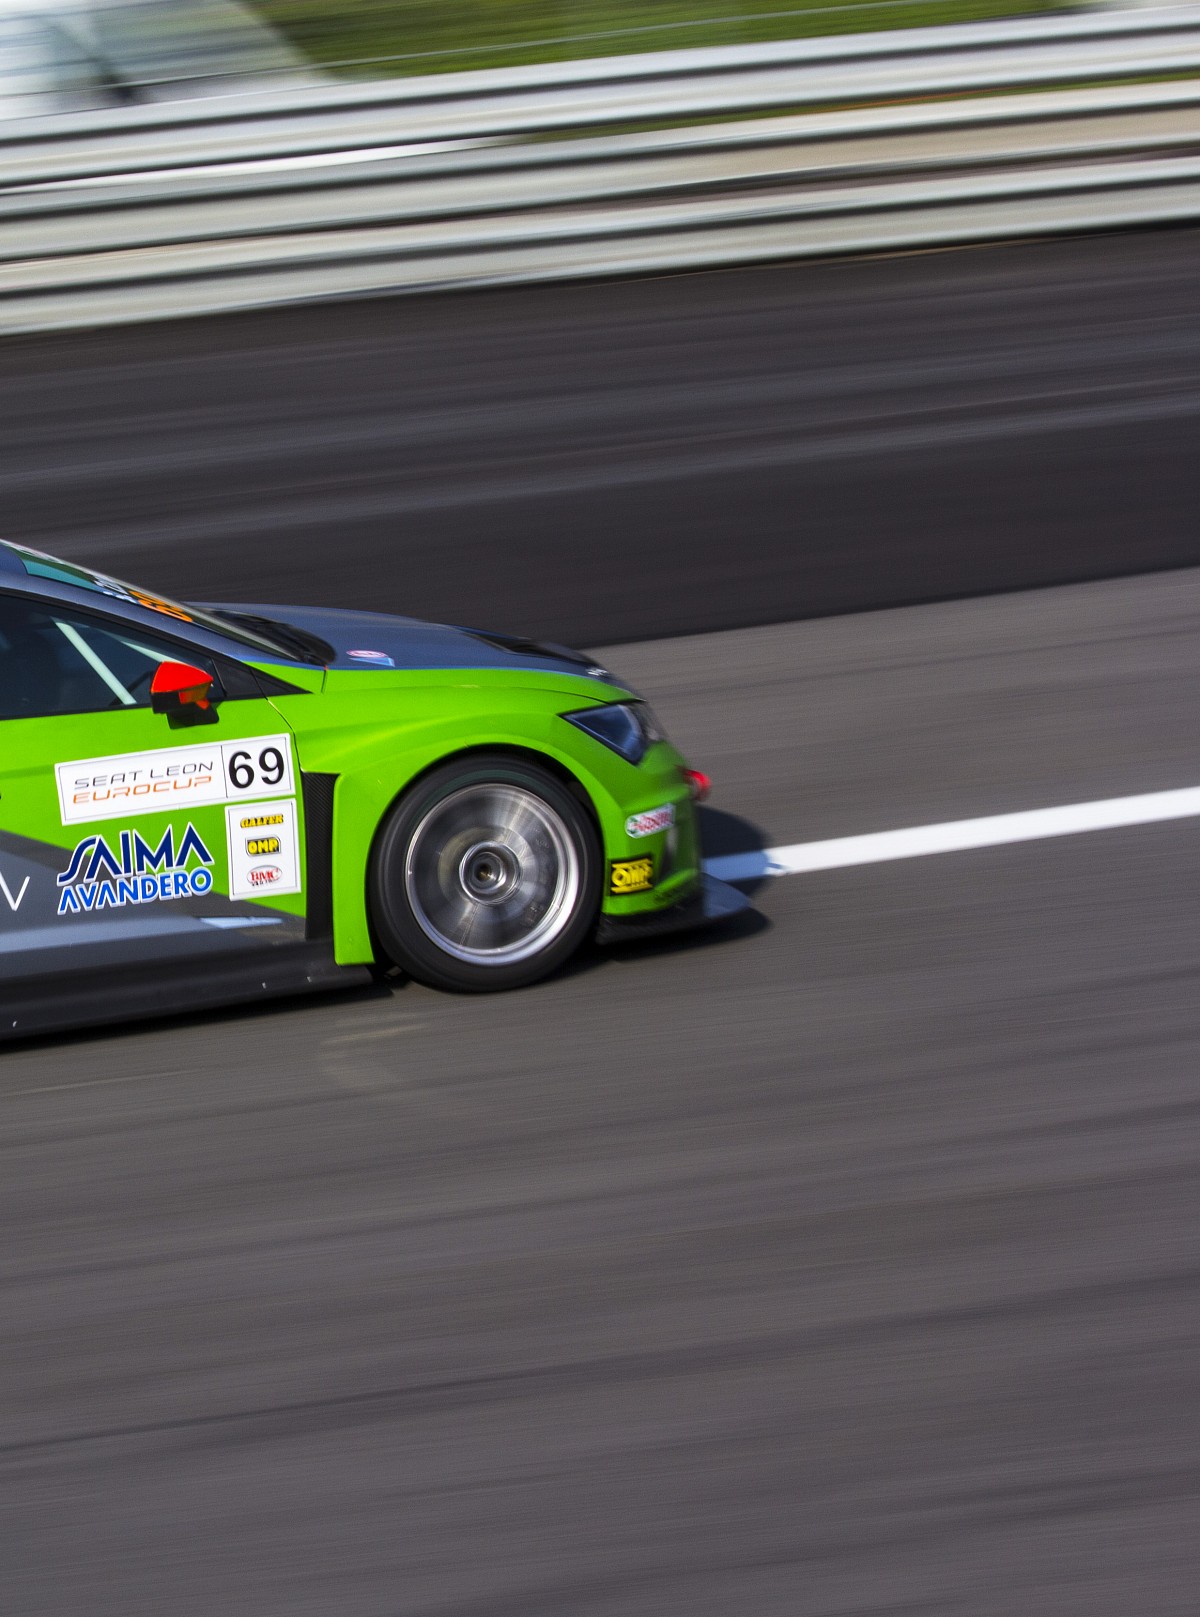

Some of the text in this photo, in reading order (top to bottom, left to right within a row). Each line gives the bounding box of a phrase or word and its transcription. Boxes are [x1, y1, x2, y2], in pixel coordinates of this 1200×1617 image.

[74, 761, 214, 790] SEAT LEON
[228, 747, 285, 790] 69
[73, 775, 213, 804] EUROCUP
[240, 813, 284, 829] GALFER
[57, 821, 215, 887] SAIMA
[247, 838, 278, 855] OMP
[611, 862, 654, 888] OMP
[57, 866, 213, 915] AVANDERO
